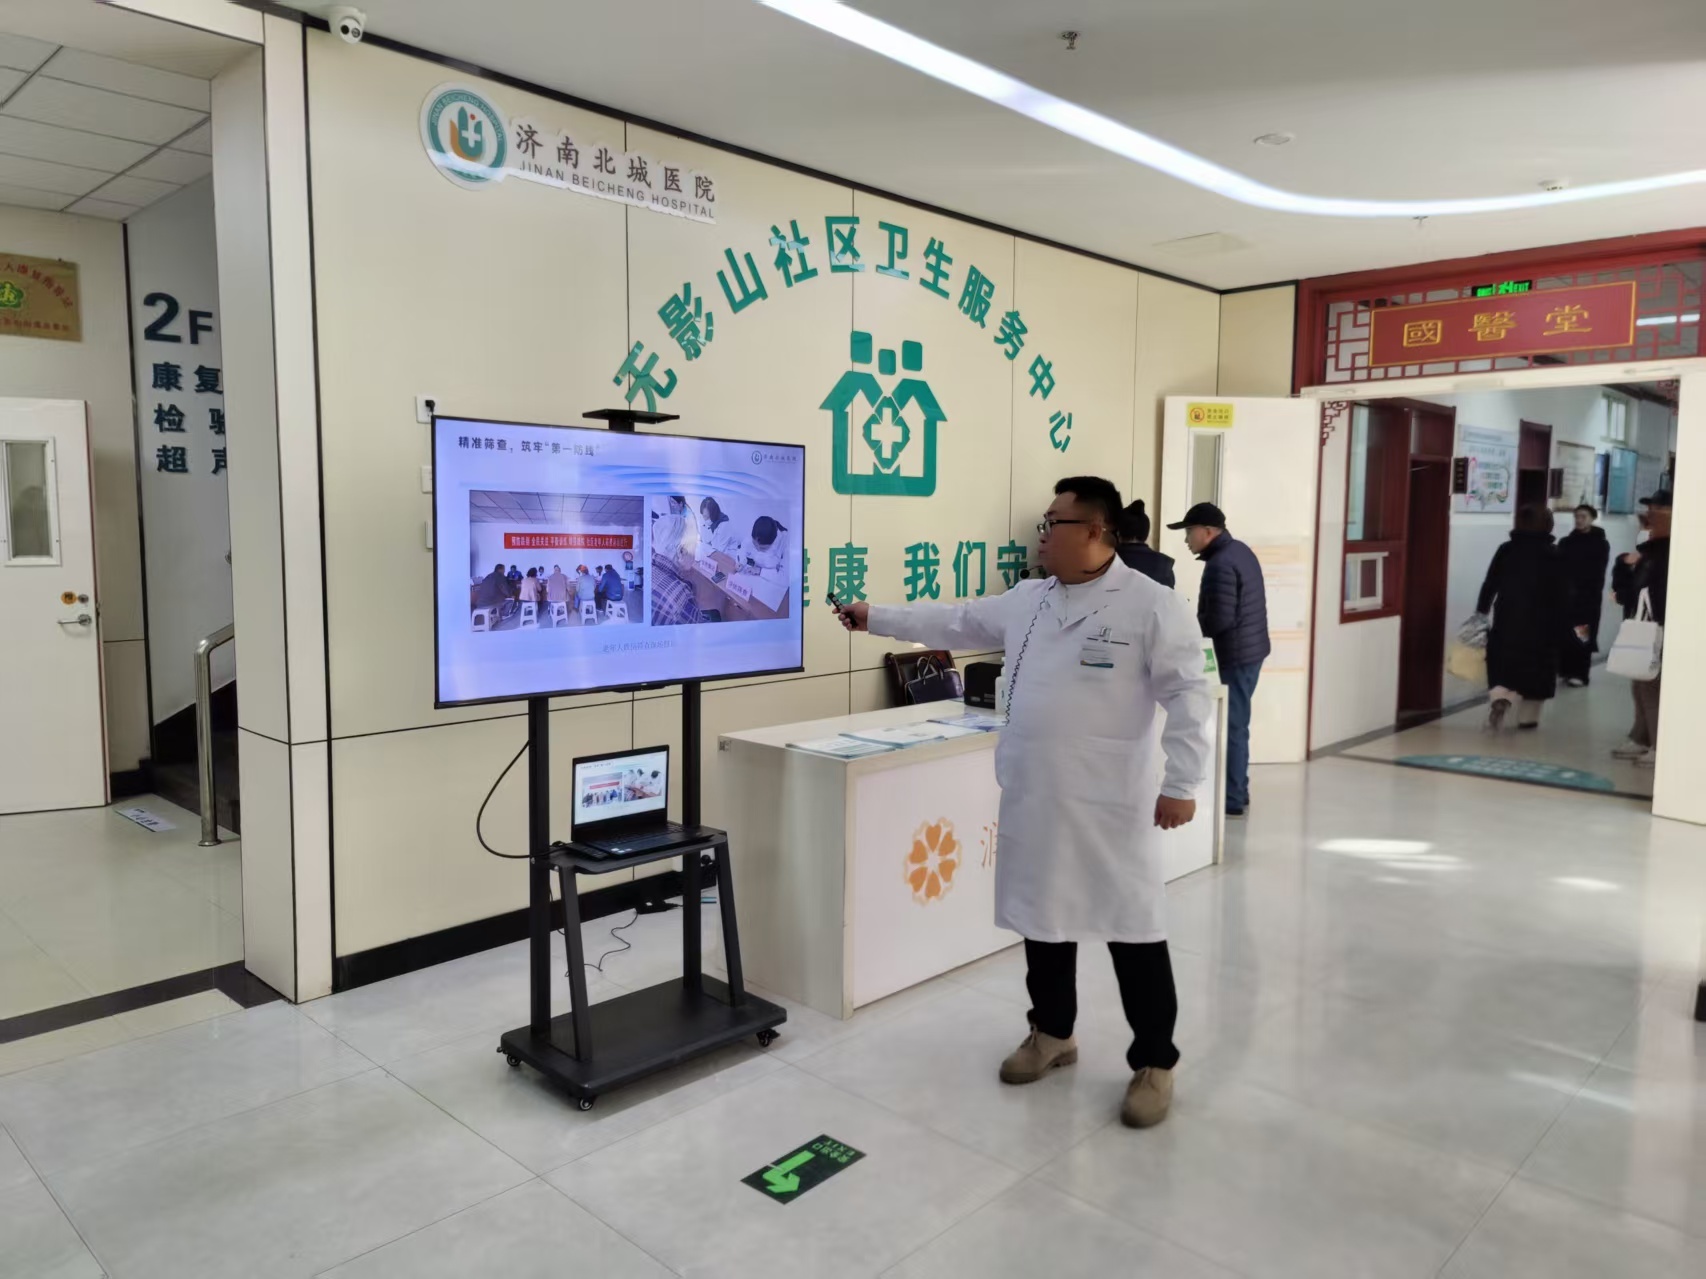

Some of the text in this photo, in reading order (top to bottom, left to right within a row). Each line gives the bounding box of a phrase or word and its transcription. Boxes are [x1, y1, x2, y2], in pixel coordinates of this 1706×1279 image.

[516, 124, 715, 203] 济南北城医院
[519, 161, 715, 219] JINAN BEICHENG HOSPITAL
[143, 292, 213, 345] 2F
[612, 216, 1074, 453] 无影山社区卫生服务中心
[1402, 304, 1593, 348] 國醫堂
[152, 361, 223, 395] 康复
[804, 539, 1047, 607] 康 我们守
